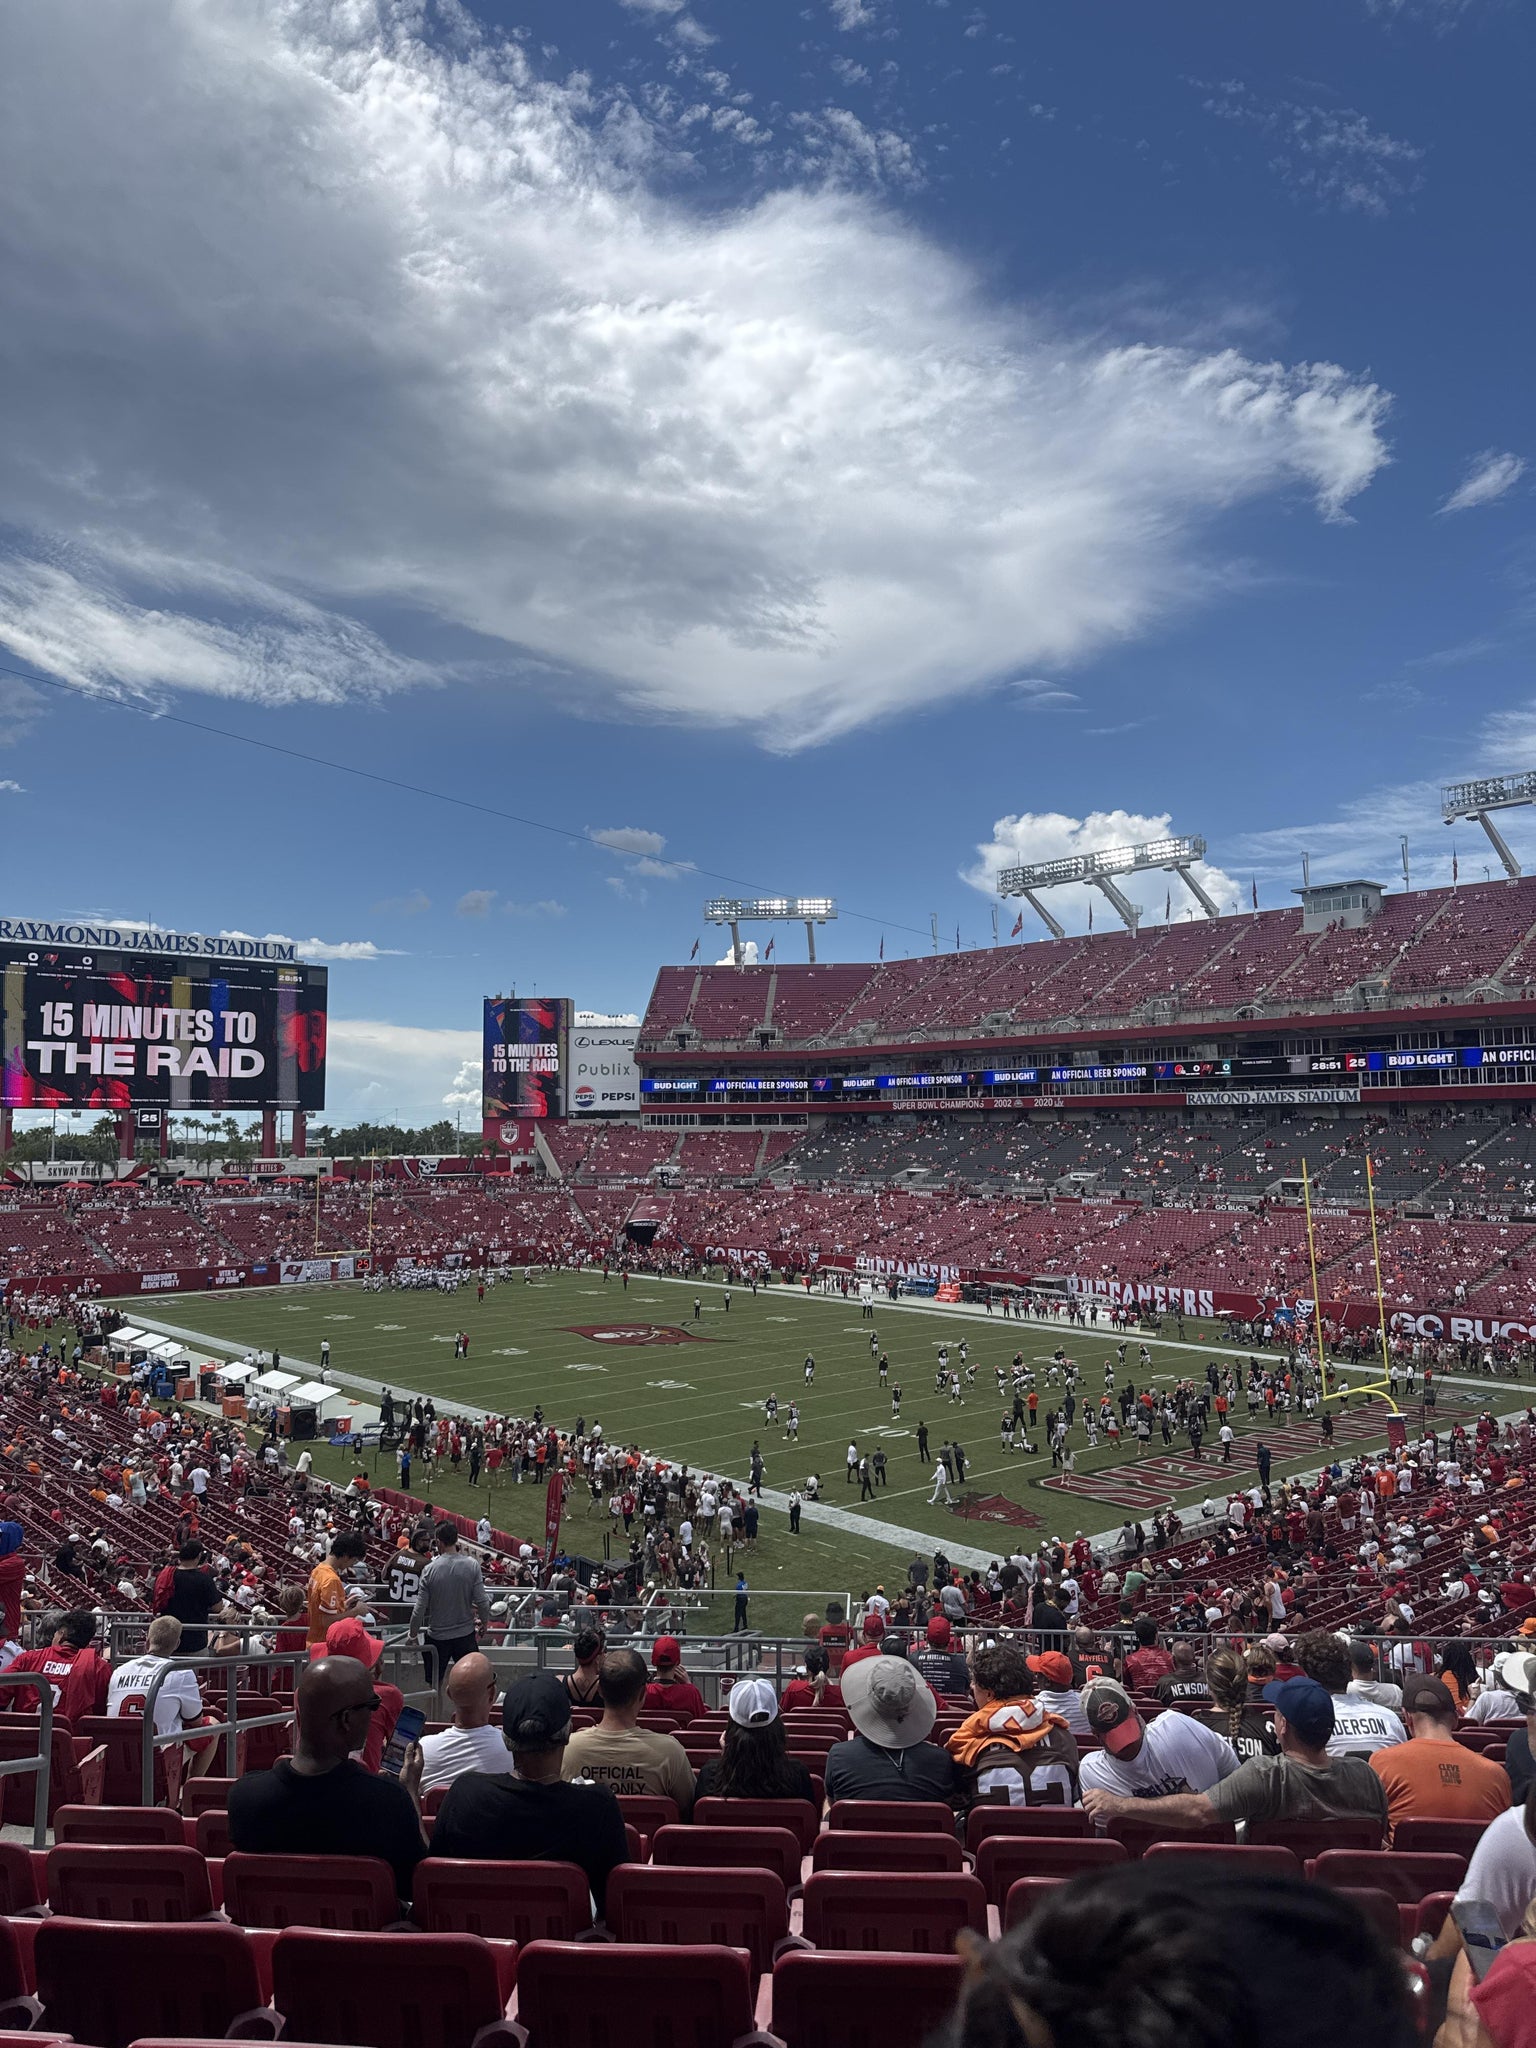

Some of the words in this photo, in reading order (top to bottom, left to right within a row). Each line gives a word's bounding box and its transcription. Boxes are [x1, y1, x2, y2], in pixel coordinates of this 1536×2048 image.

[0, 920, 121, 946] RAYMOND
[124, 931, 199, 952] JAMES
[203, 937, 296, 960] STADIUM
[40, 1002, 73, 1037] 15
[82, 1004, 213, 1043] MINUTES
[220, 1011, 257, 1044] TO
[492, 1044, 505, 1058] 15
[508, 1043, 558, 1057] MINUTES
[1482, 1051, 1497, 1062] AN
[1500, 1050, 1536, 1061] OFFICI
[27, 1040, 136, 1076] THE
[146, 1045, 265, 1078] RAID
[1349, 1058, 1366, 1068] 25
[1389, 1055, 1414, 1066] BUD
[1416, 1053, 1454, 1065] LIGHT
[491, 1059, 507, 1072] TO
[509, 1059, 530, 1072] THE
[532, 1058, 559, 1072] RAID
[577, 1062, 631, 1076] Publix
[1311, 1061, 1341, 1070] 28:51
[994, 1072, 1010, 1081] BUD
[1011, 1072, 1034, 1081] LIGHT
[1051, 1070, 1061, 1080] AN
[1062, 1069, 1092, 1079] OFFICIAL
[1094, 1068, 1111, 1078] BEER
[1113, 1067, 1147, 1077] SPONSOR
[726, 1081, 756, 1089] OFFICIAL
[776, 1081, 808, 1089] SPONSOR
[857, 1079, 875, 1087] LIGHT
[888, 1078, 896, 1086] AN
[897, 1077, 920, 1085] OFFICIAL
[920, 1076, 935, 1084] BEER
[936, 1075, 962, 1084] SPONSOR
[601, 1092, 635, 1101] PEPSI
[1187, 1092, 1250, 1105] RAYMOND
[1252, 1091, 1296, 1104] JAMES
[1299, 1090, 1359, 1102] STADIUM
[892, 1101, 916, 1110] SUPER
[917, 1101, 938, 1109] BOWL
[939, 1100, 985, 1109] CHAMPIONS
[993, 1099, 1012, 1108] 2002
[1034, 1098, 1053, 1107] 2020
[141, 1113, 158, 1123] 25
[48, 1167, 79, 1177] SKYWAY
[260, 1163, 278, 1172] BITES
[1162, 1201, 1175, 1209] GO
[356, 1260, 369, 1270] 25
[160, 1280, 180, 1288] PARTY
[1390, 1312, 1444, 1338] GO
[646, 1379, 690, 1389] 30
[855, 1424, 911, 1438] 10
[397, 1555, 416, 1568] BROWN
[389, 1568, 420, 1603] 32
[1078, 1653, 1109, 1664] MAYFIELD
[1085, 1664, 1103, 1682] 6
[117, 1674, 164, 1689] MAYFIE
[581, 1766, 645, 1780] OFFICIAL
